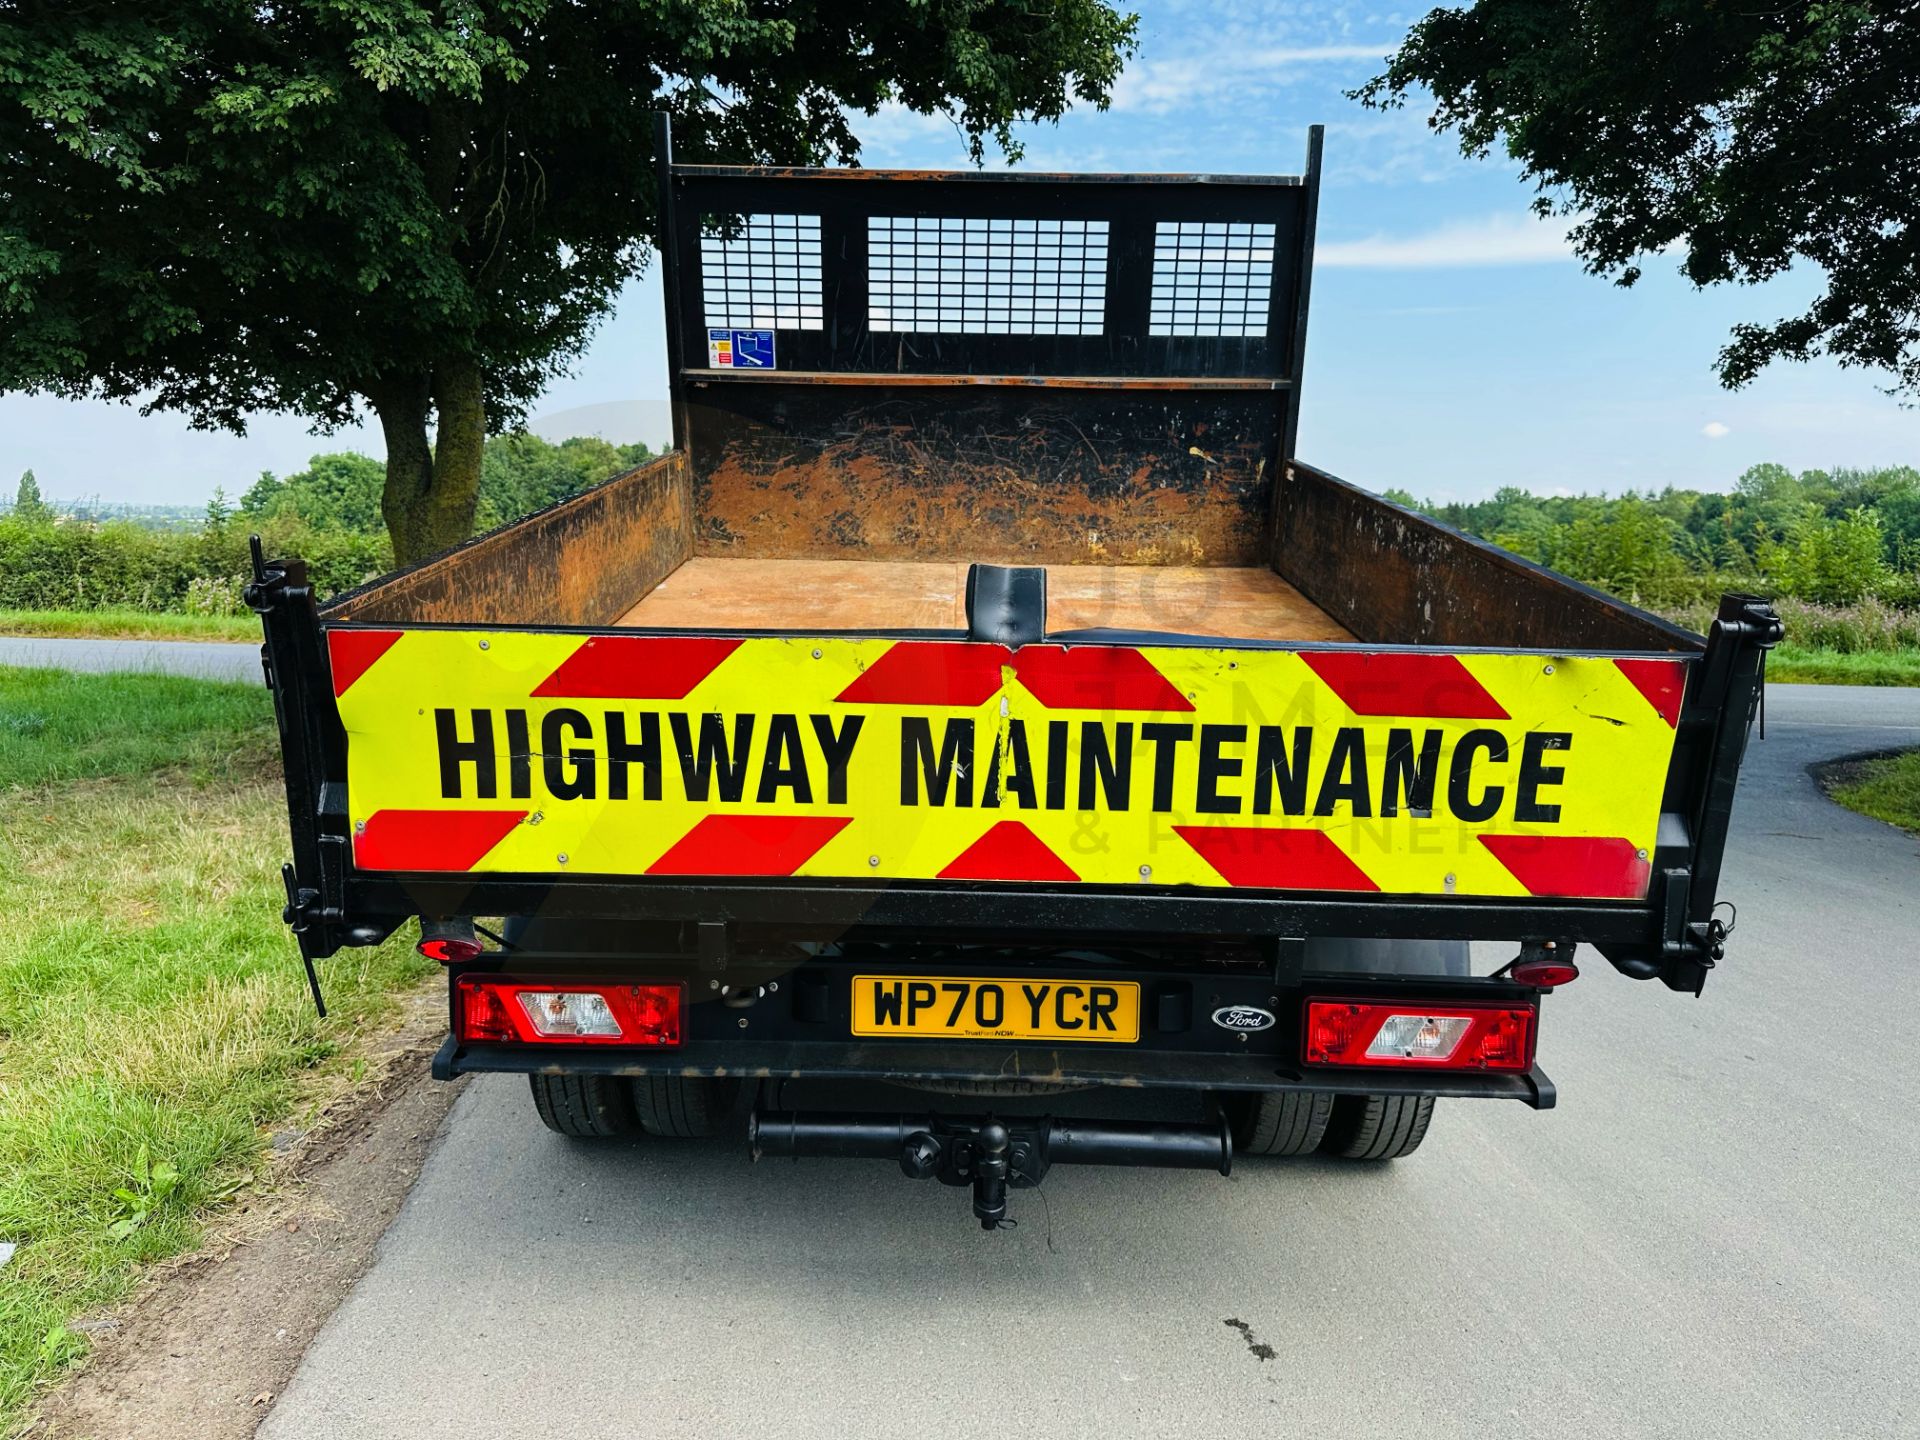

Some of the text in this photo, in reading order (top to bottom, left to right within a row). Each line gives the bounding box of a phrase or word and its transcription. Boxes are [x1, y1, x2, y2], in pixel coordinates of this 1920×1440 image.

[433, 707, 1573, 823] HIGHWAY MAINTENANCE
[873, 981, 1118, 1031] WP70 YCR
[1226, 1009, 1263, 1027] Ford
